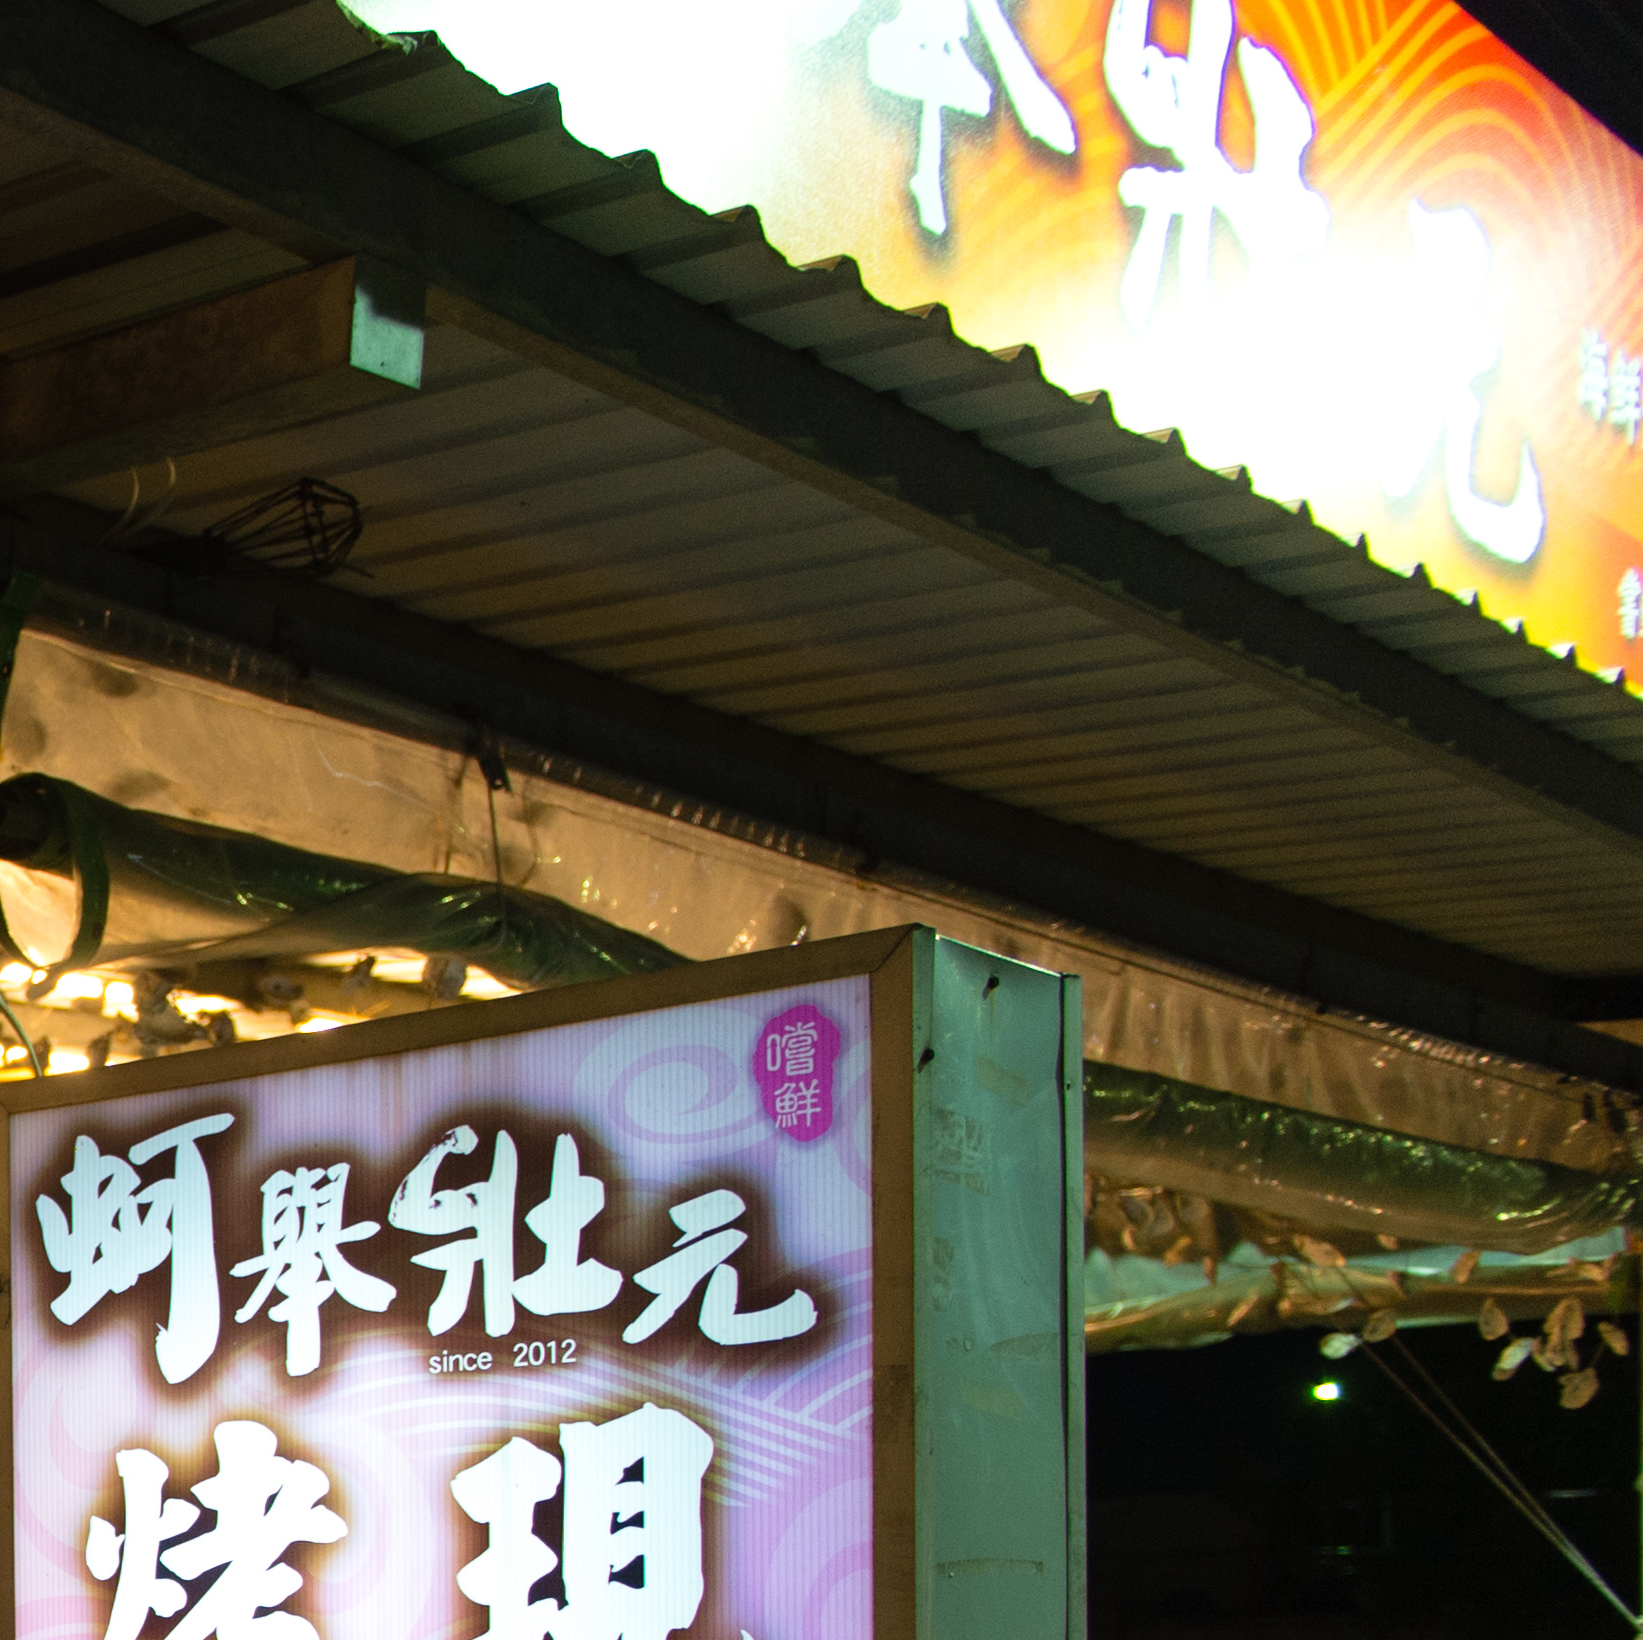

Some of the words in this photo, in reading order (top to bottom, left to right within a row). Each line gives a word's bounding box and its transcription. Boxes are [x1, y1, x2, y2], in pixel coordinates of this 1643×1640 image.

[36, 1112, 818, 1385] 蚵舉壯元
[428, 1350, 494, 1375] since
[512, 1340, 578, 1369] 2012
